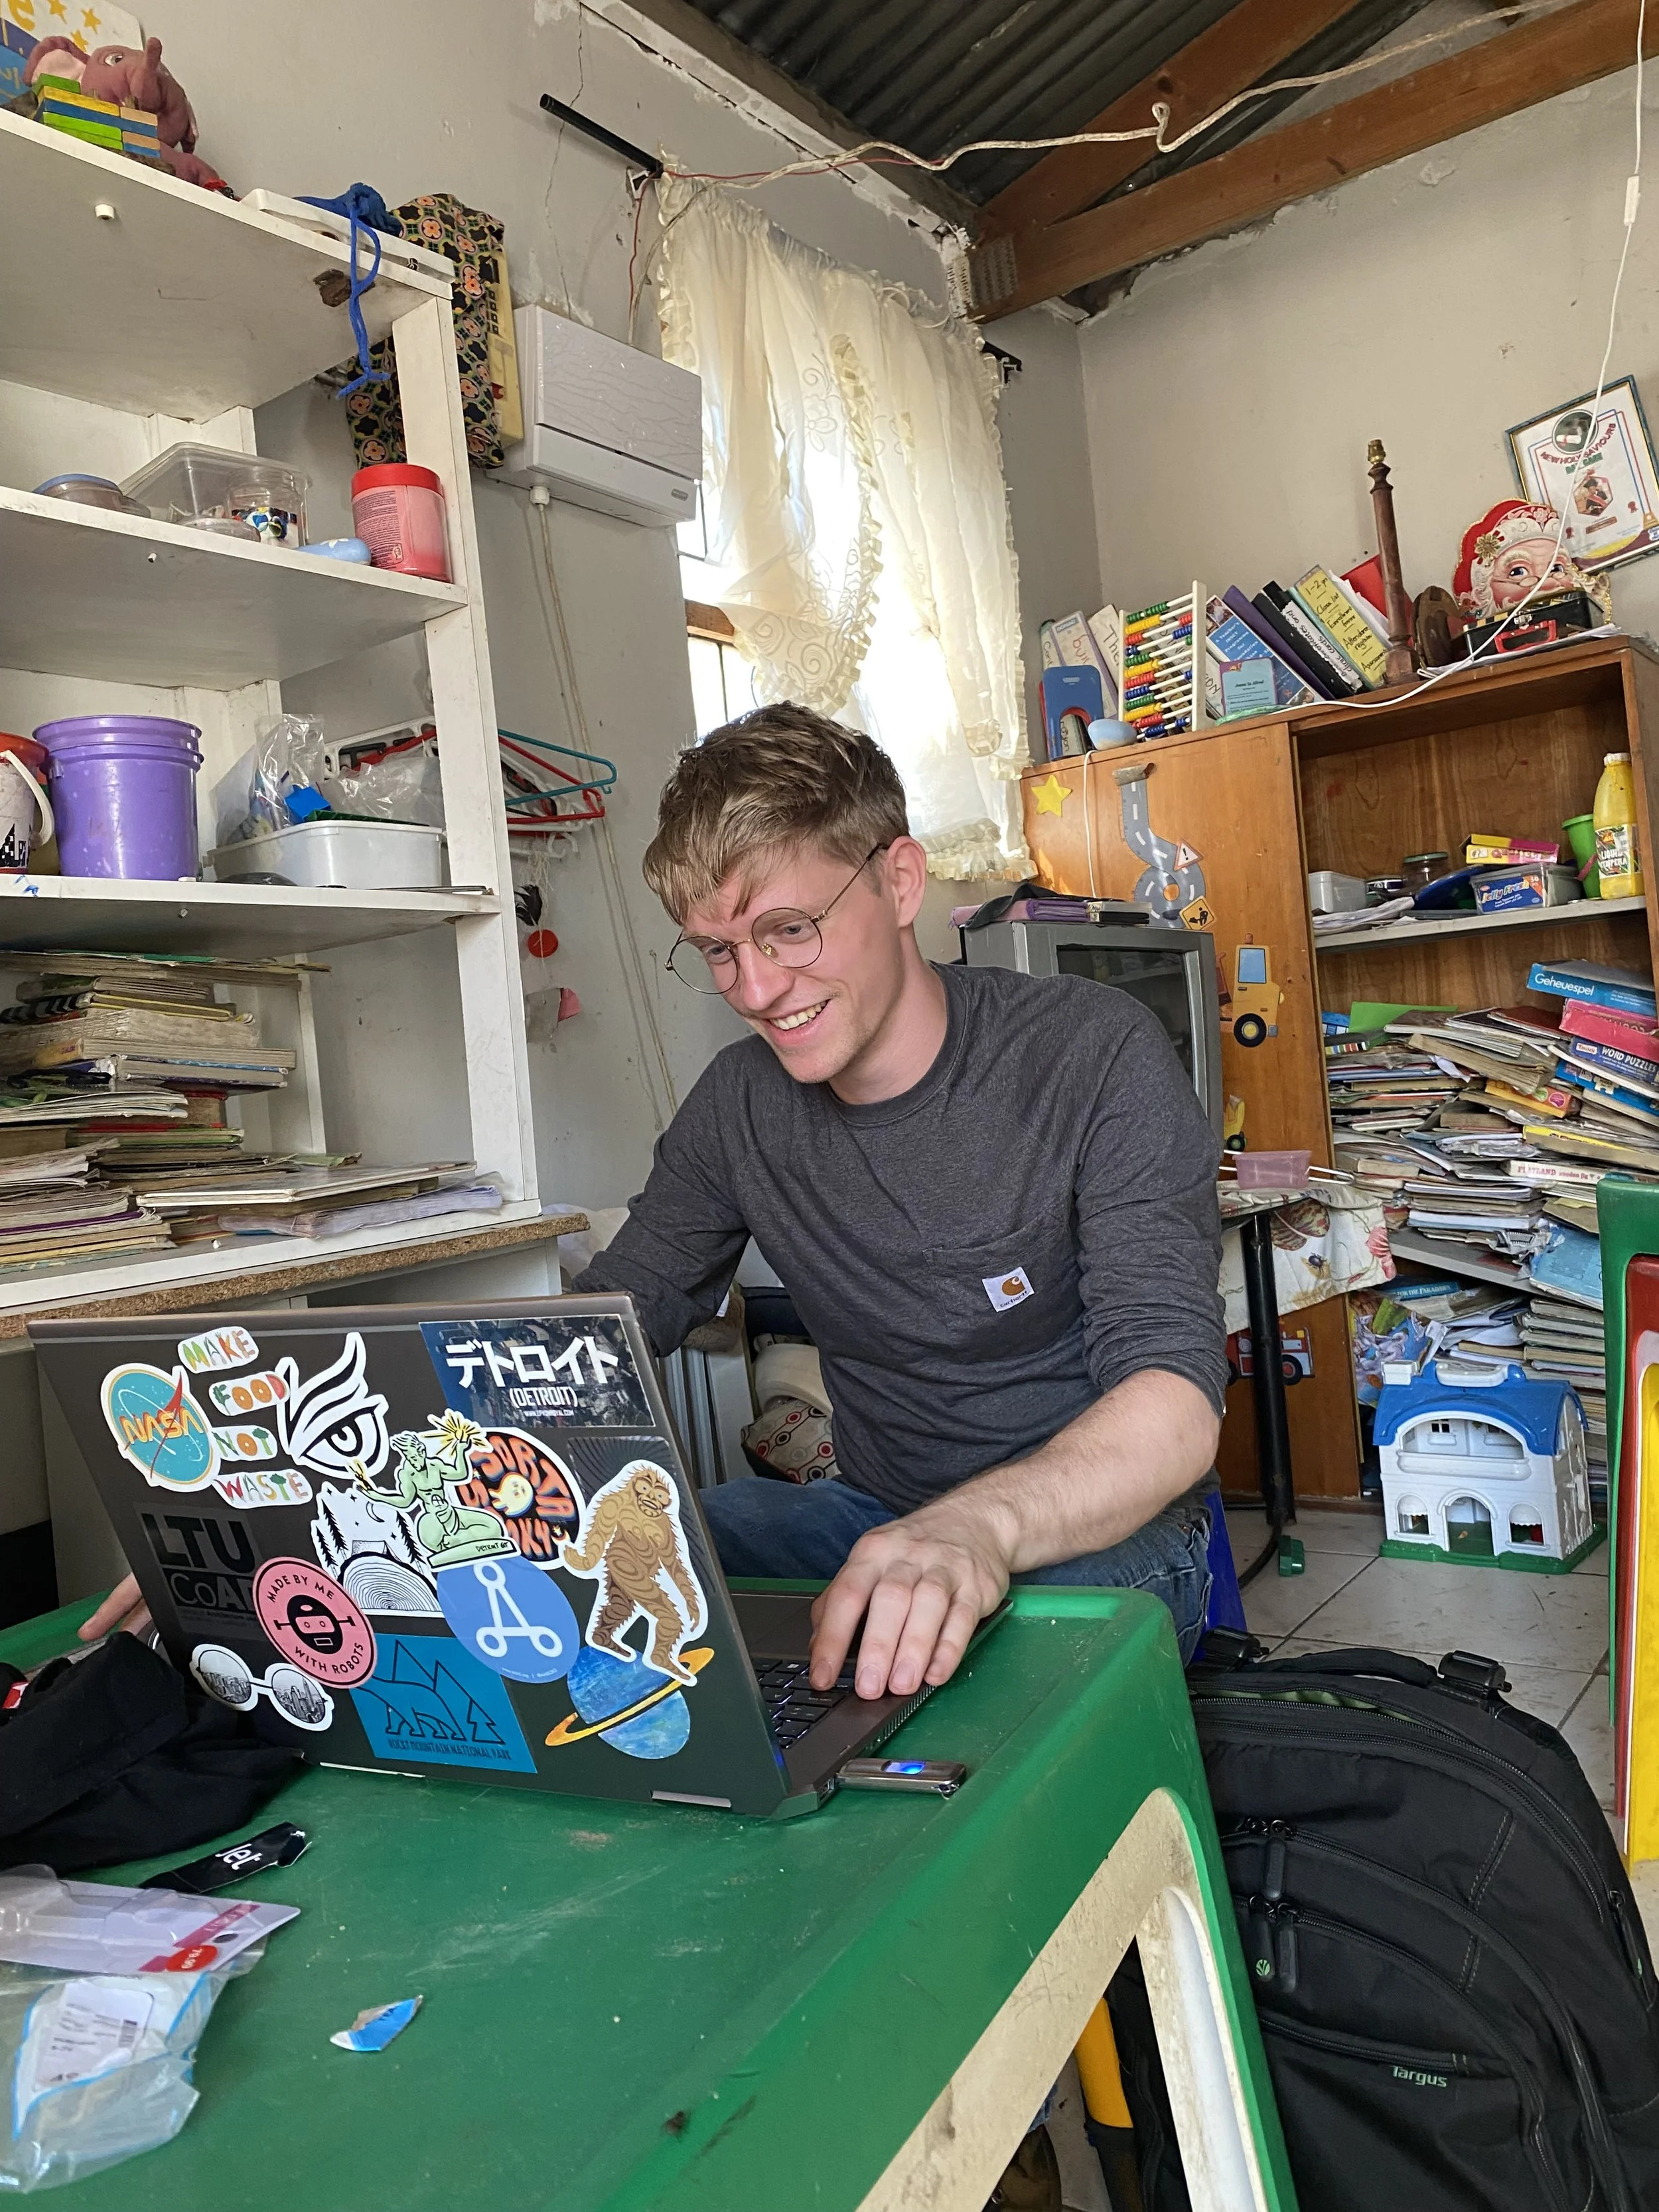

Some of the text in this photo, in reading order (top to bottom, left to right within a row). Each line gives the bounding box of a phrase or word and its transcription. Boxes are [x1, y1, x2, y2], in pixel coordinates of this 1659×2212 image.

[1601, 1046, 1624, 1062] WORD
[1625, 1055, 1657, 1073] PUZZLES
[1000, 1291, 1027, 1307] carhartt
[182, 1331, 255, 1368] MAKE
[446, 1336, 618, 1388] デトロイト
[212, 1374, 287, 1414] FOOD
[120, 1409, 204, 1445] NASA
[213, 1428, 270, 1457] NOT
[216, 1471, 309, 1501] WASTE
[141, 1512, 255, 1573] LTU
[267, 1574, 334, 1603] MADE BY ME
[295, 1643, 364, 1674] WITH ROBOTS
[409, 1740, 451, 1754] MOUNTAIN
[451, 1744, 492, 1758] NATIONAL
[1392, 2065, 1447, 2087] Targus
